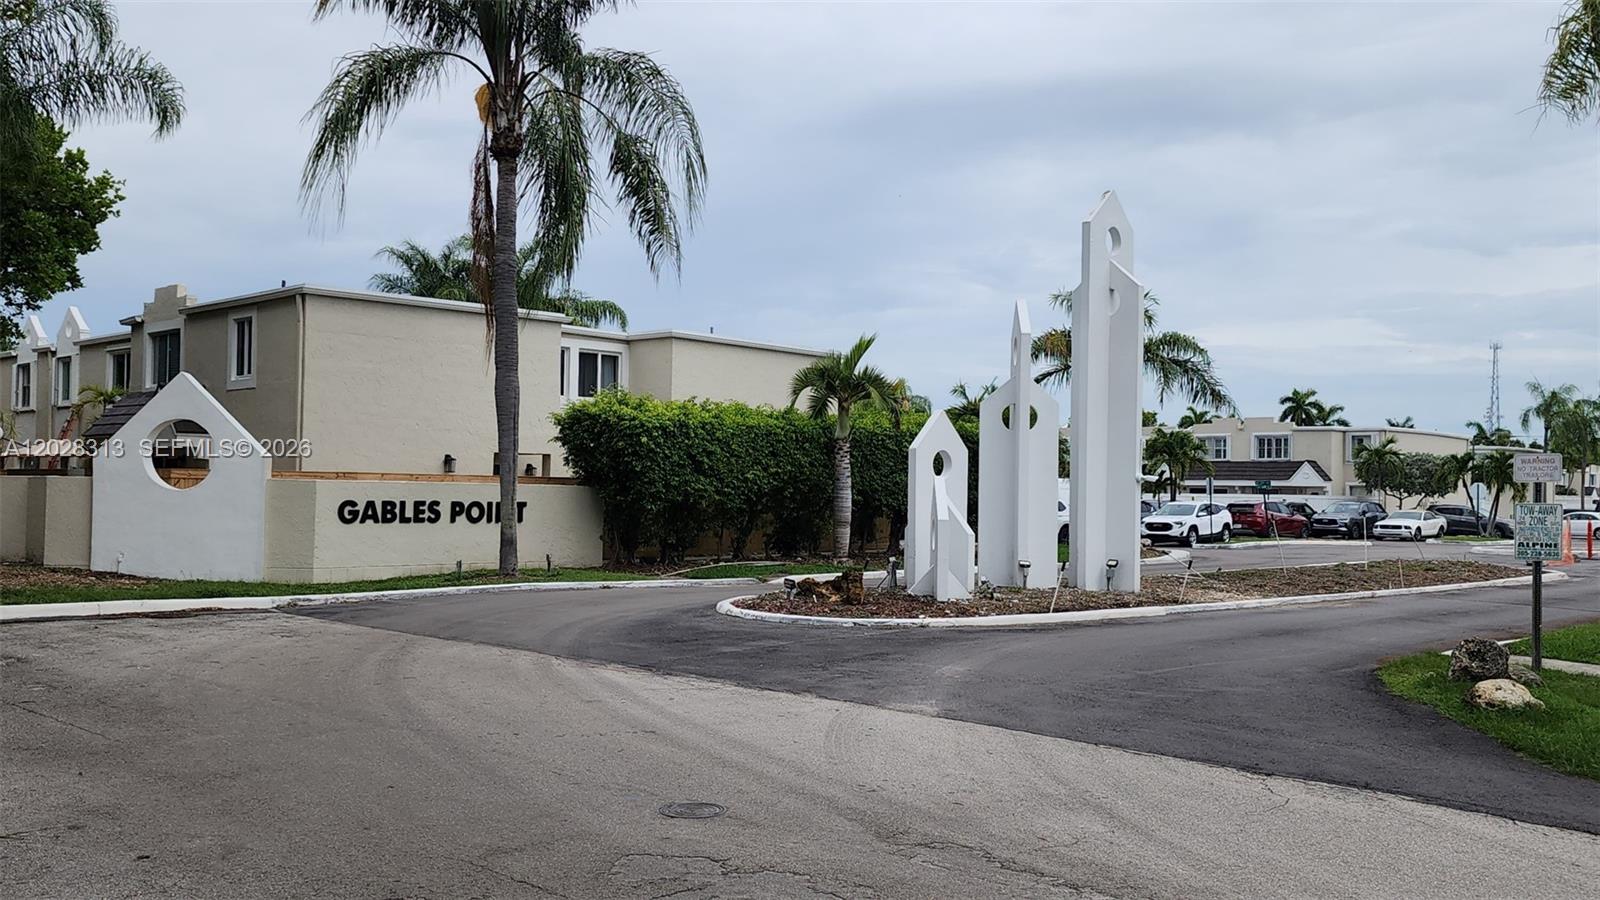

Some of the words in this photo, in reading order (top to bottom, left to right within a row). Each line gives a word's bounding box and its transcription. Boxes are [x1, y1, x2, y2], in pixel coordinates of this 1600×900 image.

[337, 499, 441, 525] GABLES
[1519, 505, 1558, 515] TOW-AWAY
[1529, 516, 1548, 526] ZONE
[1517, 541, 1559, 549] ALPINE
